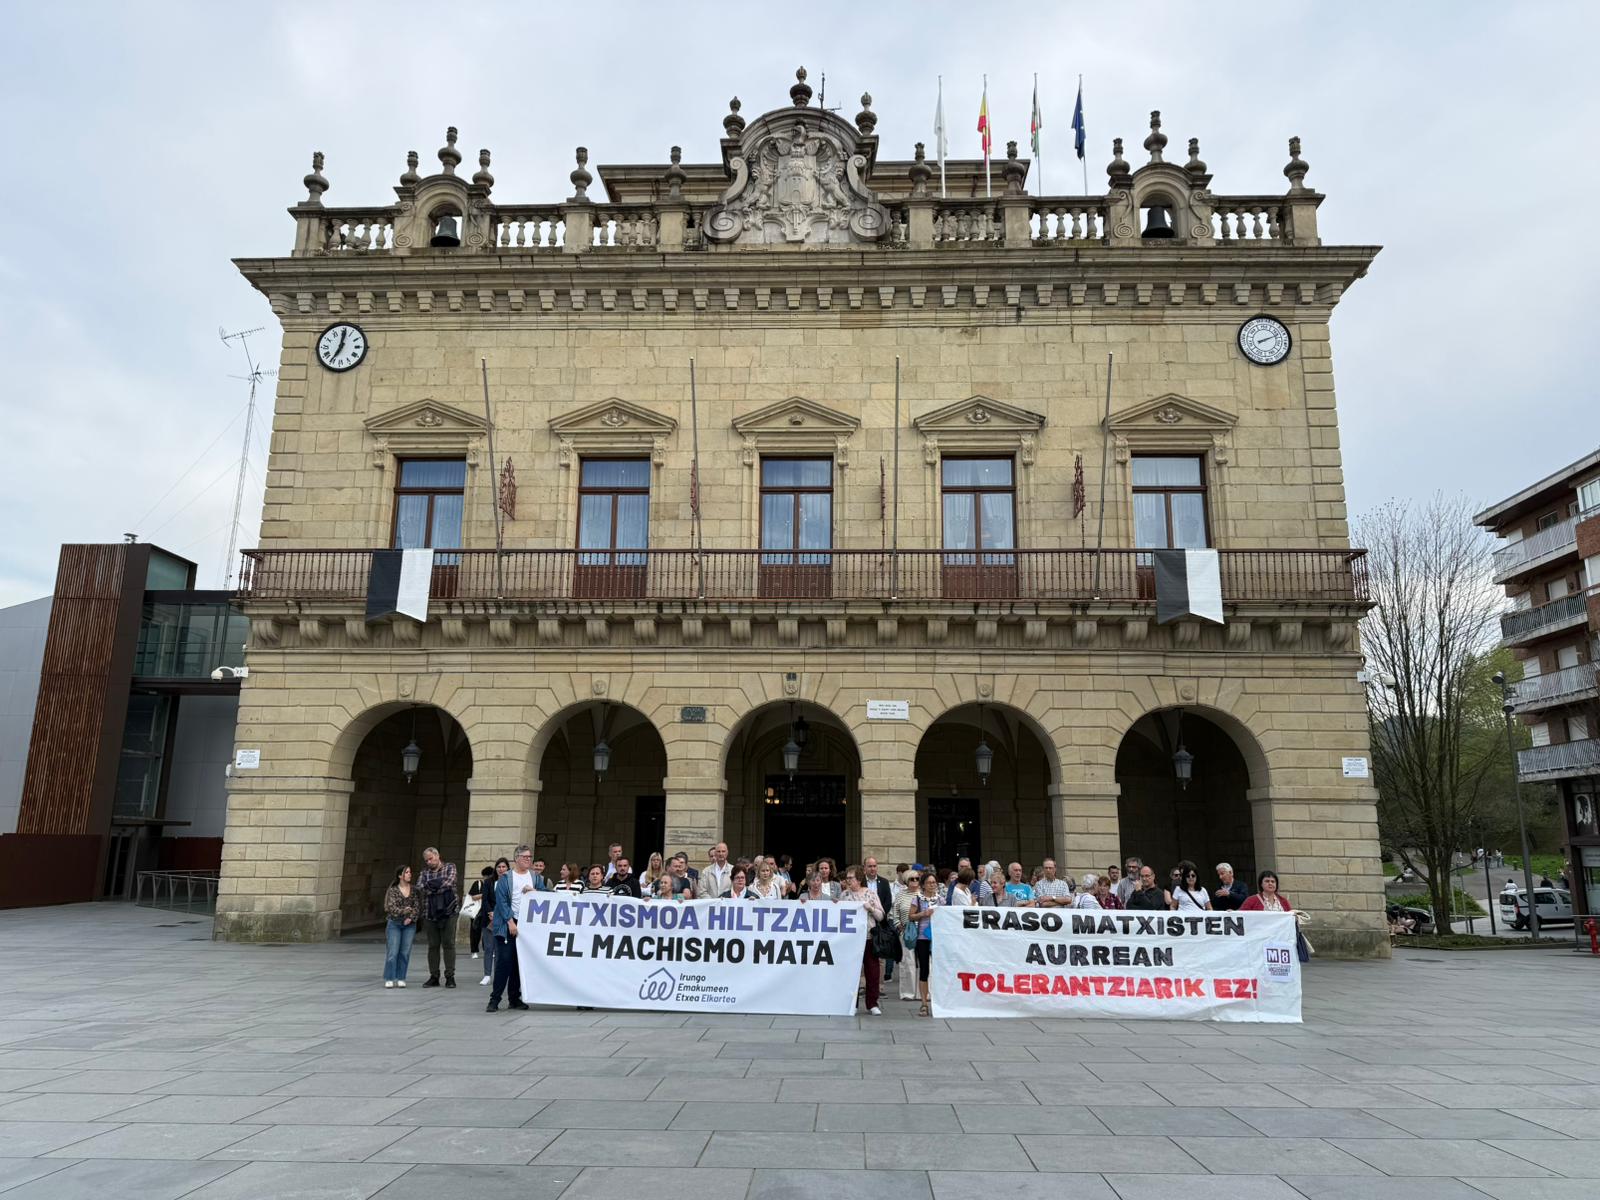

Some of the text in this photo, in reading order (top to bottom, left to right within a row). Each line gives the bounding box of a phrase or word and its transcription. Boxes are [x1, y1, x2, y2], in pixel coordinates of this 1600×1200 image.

[526, 899, 857, 933] MATXISMOA HILTZAILE
[962, 909, 1245, 936] ERASO MATXISTEN
[546, 932, 834, 965] EL MACHISMO MATA
[1025, 943, 1174, 966] AURREAN
[677, 983, 729, 993] Emakumeen
[679, 973, 706, 983] Irungo
[957, 972, 1258, 999] TOLERANTZIARIK EZ!
[675, 993, 736, 1003] Etxea Elkartea
